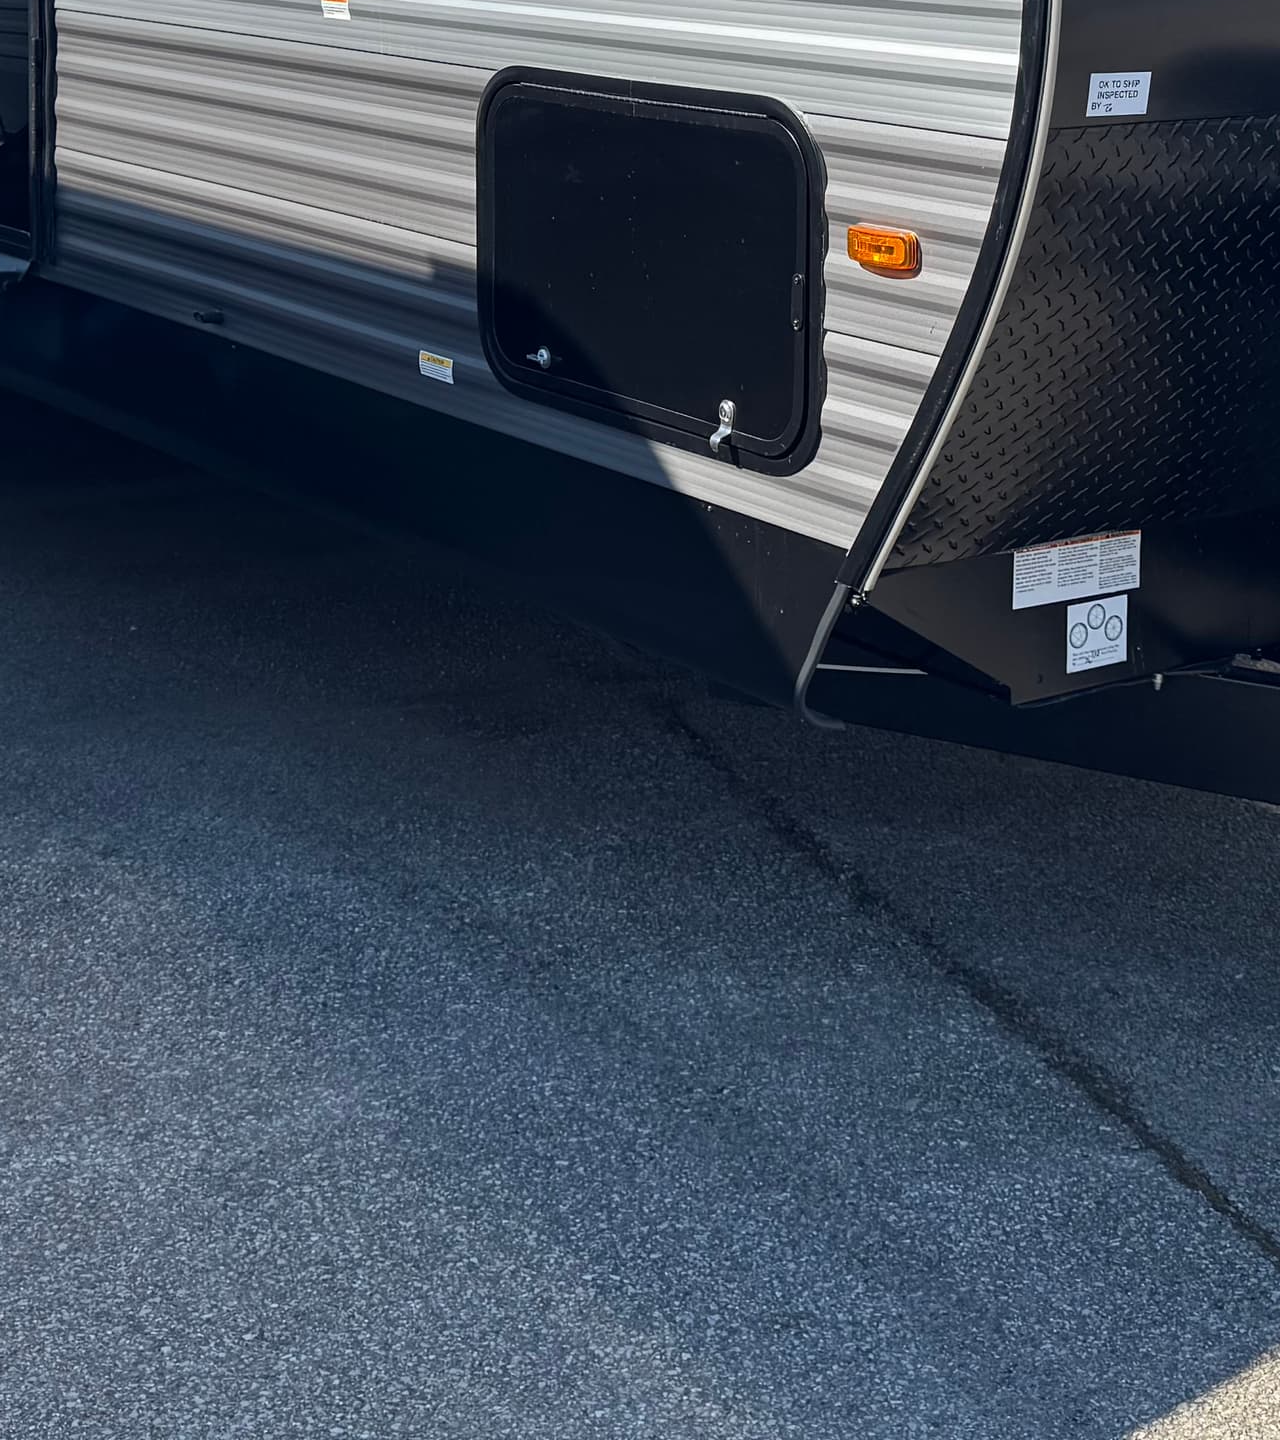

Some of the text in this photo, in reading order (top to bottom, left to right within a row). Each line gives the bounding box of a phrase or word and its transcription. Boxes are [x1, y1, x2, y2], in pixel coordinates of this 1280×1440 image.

[1112, 80, 1121, 88] TO
[1097, 90, 1138, 99] INSPECTED
[1091, 102, 1102, 111] BY
